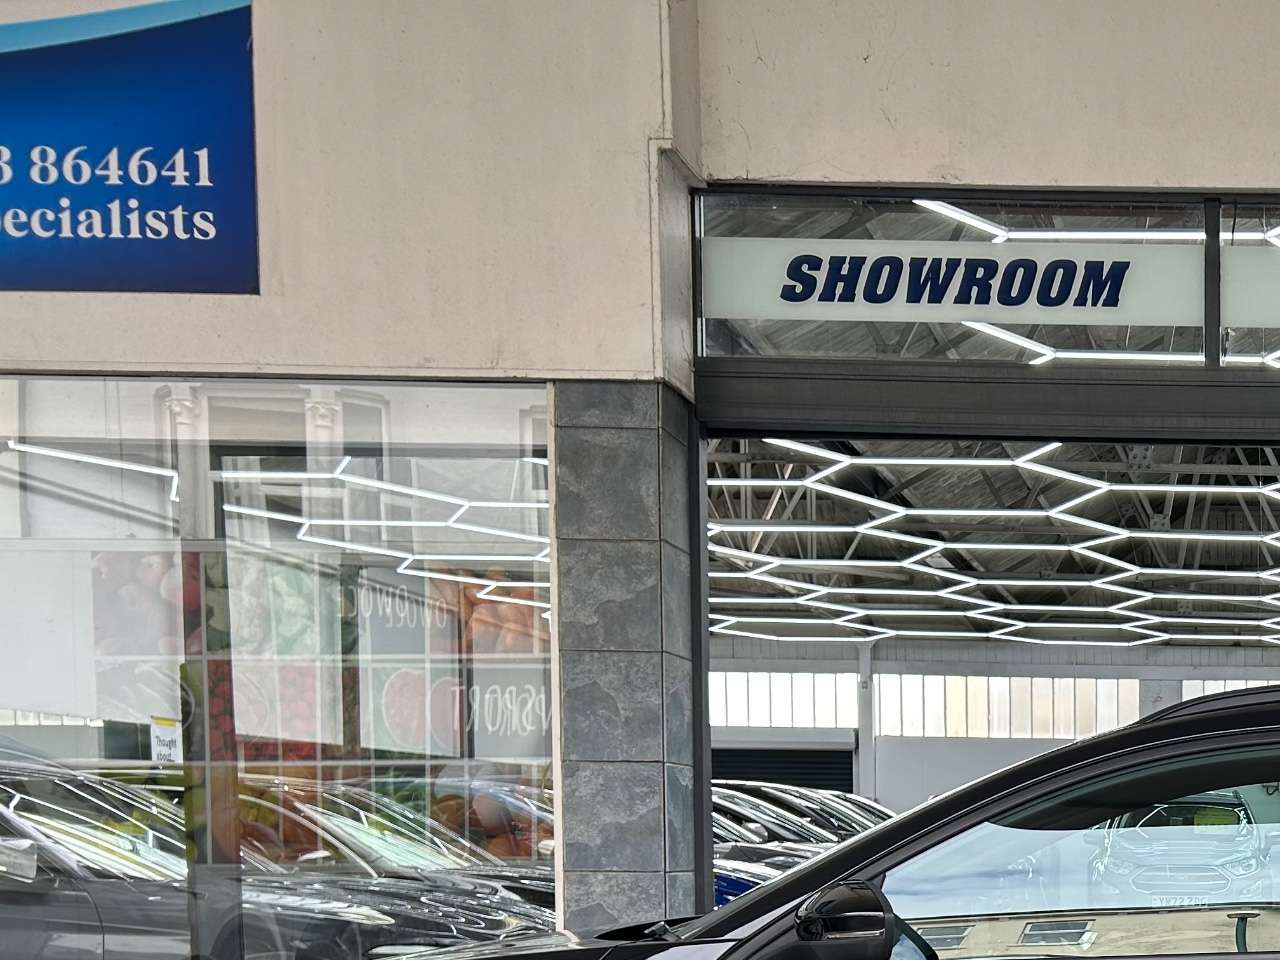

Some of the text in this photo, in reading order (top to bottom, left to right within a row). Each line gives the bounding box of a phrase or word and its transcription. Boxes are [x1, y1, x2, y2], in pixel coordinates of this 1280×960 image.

[29, 145, 214, 187] 864641
[0, 197, 217, 240] ecialists
[779, 254, 1131, 308] SHOWROOM
